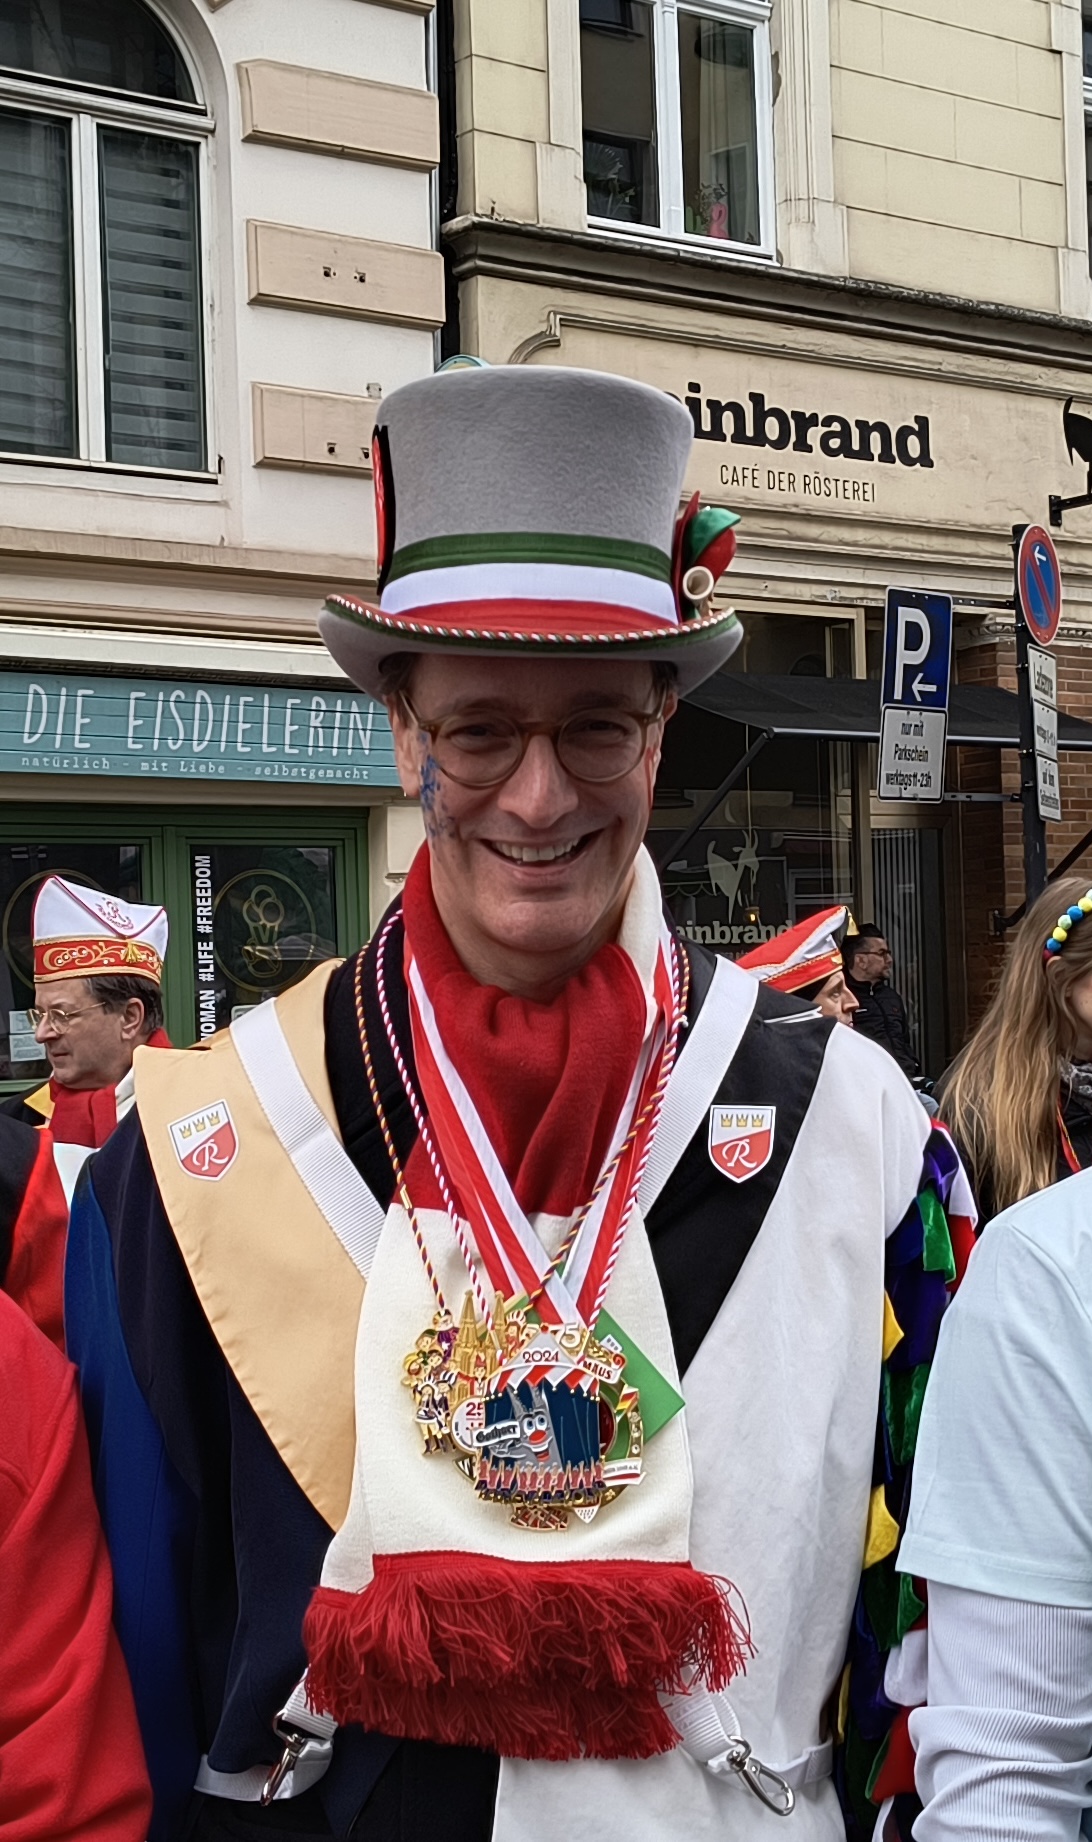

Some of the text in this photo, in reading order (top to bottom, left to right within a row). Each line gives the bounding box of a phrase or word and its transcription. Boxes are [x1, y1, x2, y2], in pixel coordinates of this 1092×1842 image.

[664, 381, 935, 468] inbrand
[720, 463, 875, 502] CAFÉ DER RÖSTEREI
[893, 606, 931, 700] P
[23, 683, 375, 757] DIE EISDIELERIN
[21, 756, 110, 770] natürlich
[140, 760, 168, 772] mit
[179, 760, 225, 774] Liebe
[254, 764, 370, 780] selbstgemacht
[894, 743, 928, 763] Parkschein
[195, 855, 214, 934] #FREEDOM
[198, 941, 215, 982] #LIFE
[522, 1350, 560, 1364] 2024
